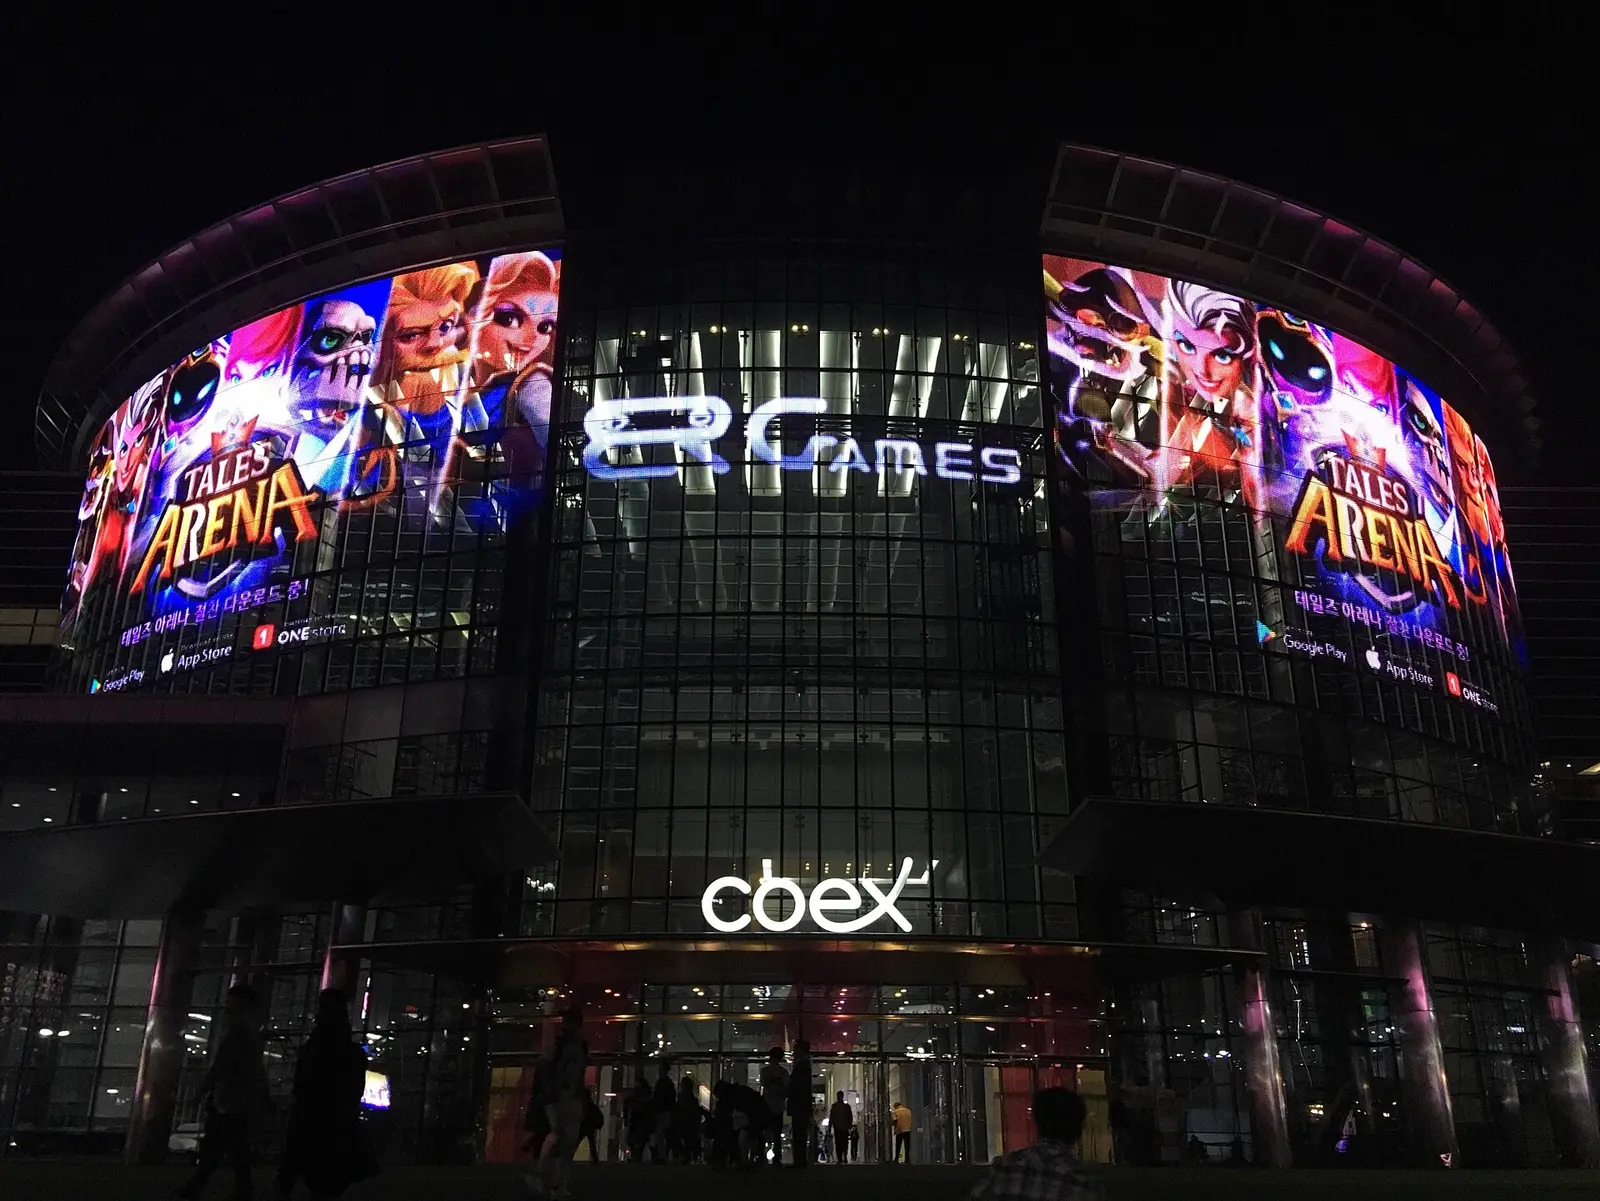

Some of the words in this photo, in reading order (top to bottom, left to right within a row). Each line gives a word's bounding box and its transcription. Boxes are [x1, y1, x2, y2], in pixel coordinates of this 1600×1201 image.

[184, 449, 270, 502] TALES
[1327, 455, 1409, 515] TALES
[130, 463, 319, 595] ARENA
[1285, 476, 1460, 610] ARENA
[121, 619, 151, 646] 테일즈
[154, 606, 189, 635] 아레나
[224, 584, 285, 613] 다운로드
[278, 626, 310, 645] ONE
[1294, 590, 1339, 616] 테일즈
[1342, 602, 1382, 630] 아레나
[1413, 625, 1455, 655] 다운로드
[178, 653, 200, 670] App
[201, 645, 232, 662] Store
[1283, 634, 1325, 657] Google
[1325, 643, 1347, 663] Play
[1386, 660, 1408, 680] App
[1408, 666, 1434, 688] Store
[102, 671, 128, 693] Google
[128, 668, 146, 683] Play
[1462, 687, 1482, 705] ONE
[701, 856, 914, 933] coex
